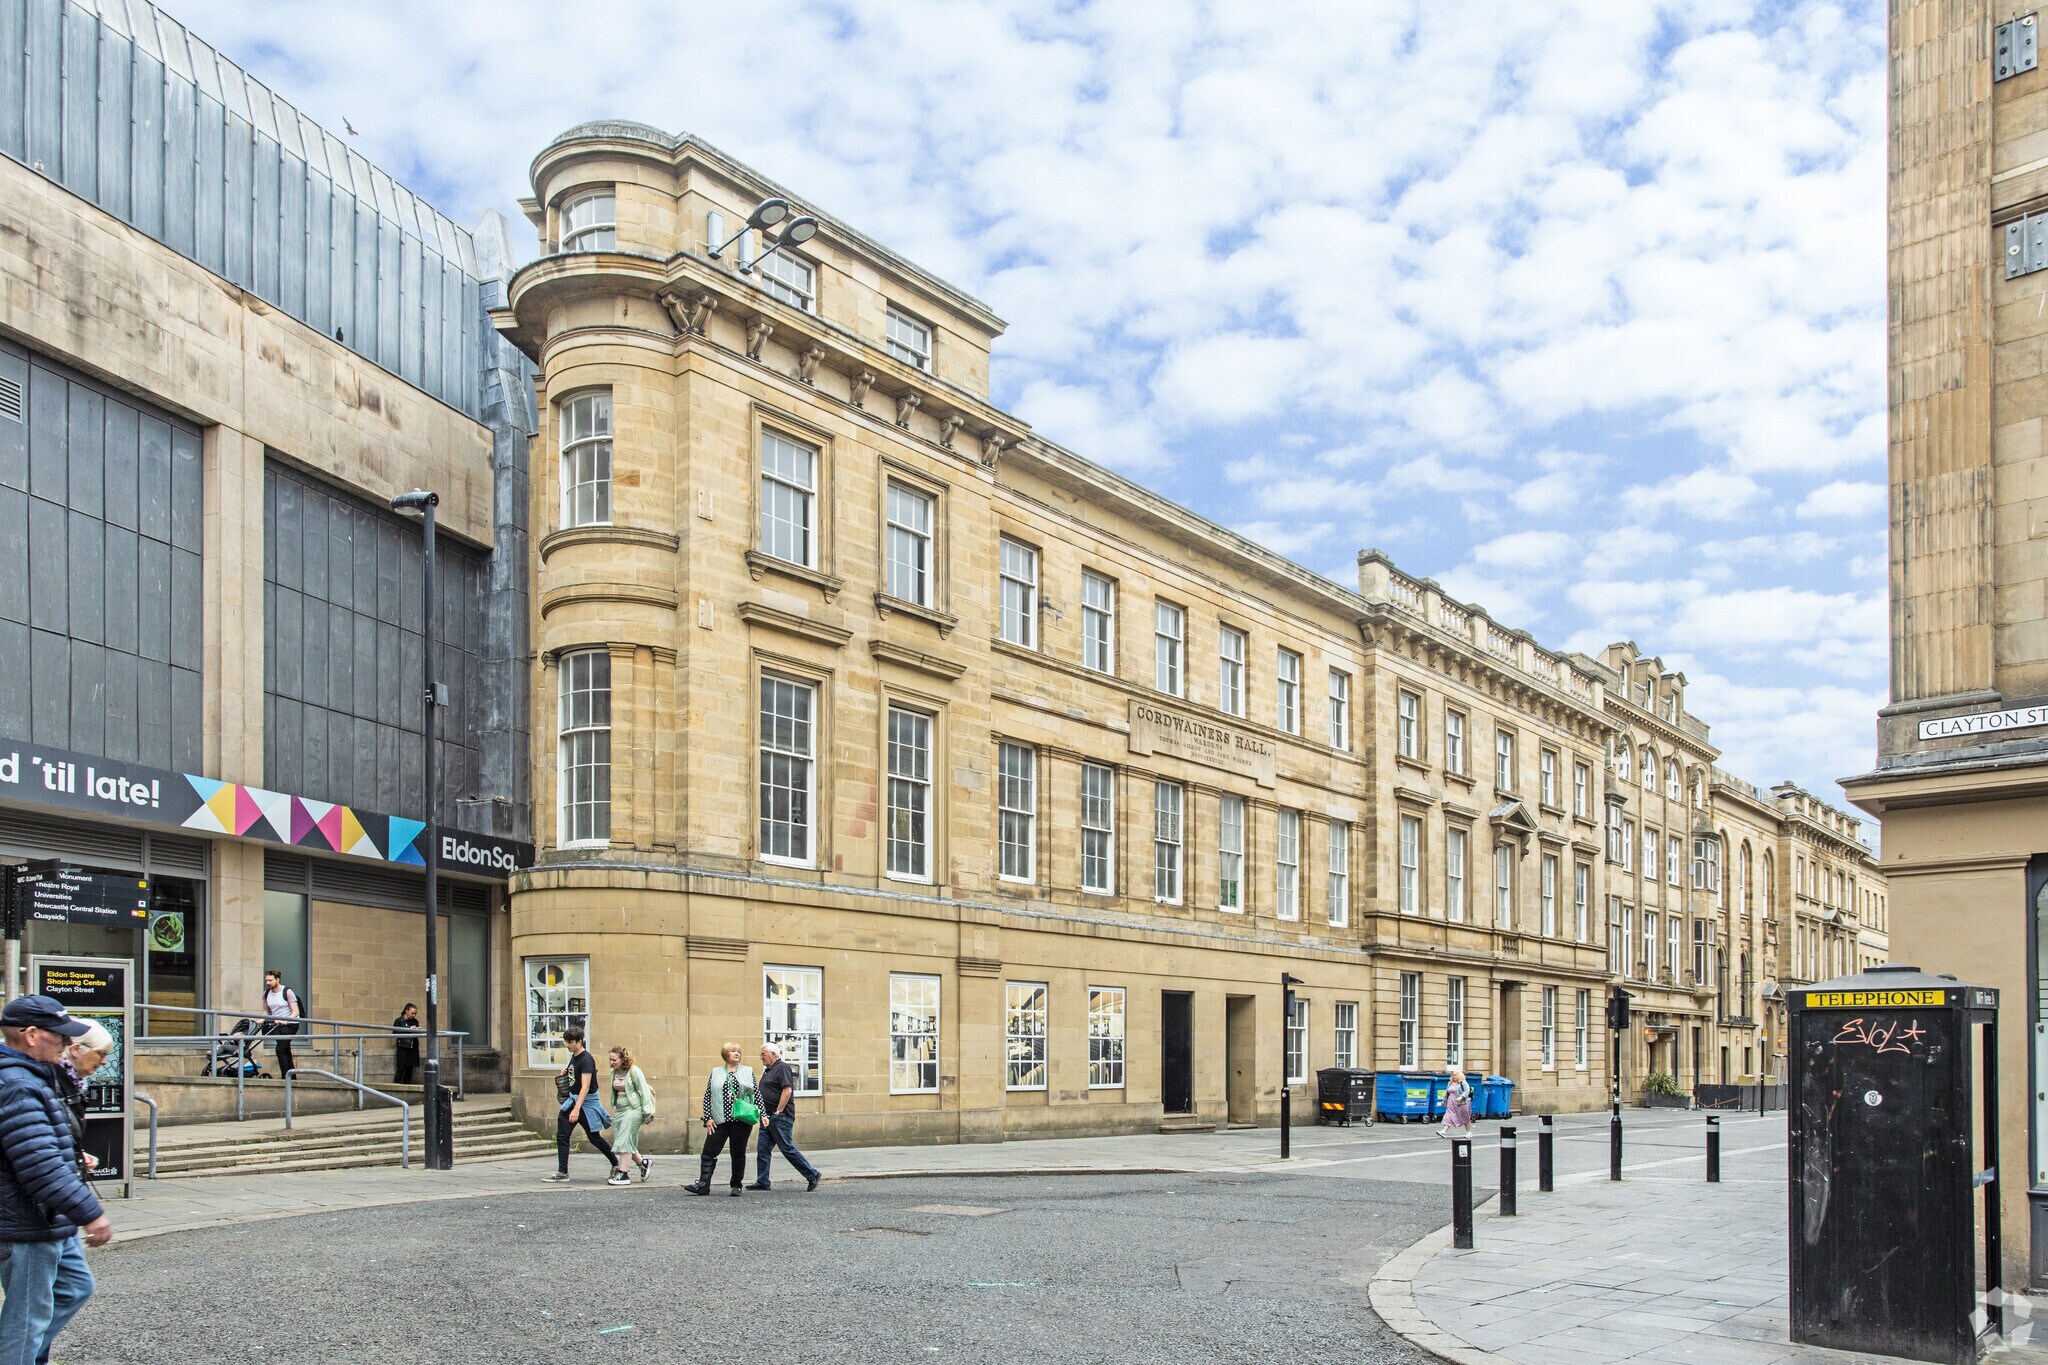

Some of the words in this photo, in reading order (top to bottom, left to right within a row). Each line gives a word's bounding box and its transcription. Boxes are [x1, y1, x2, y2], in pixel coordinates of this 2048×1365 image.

[1926, 711, 2018, 736] CLAYTON
[1137, 706, 1230, 745] CORDWAINERS
[1235, 735, 1271, 757] HALL.
[1194, 737, 1223, 750] WARDENS
[86, 767, 160, 808] late!
[59, 873, 92, 882] Monument
[61, 883, 80, 892] Royal
[34, 891, 72, 900] Universities
[34, 902, 69, 911] Newcastle
[70, 904, 94, 912] Central
[94, 906, 118, 915] Station
[34, 912, 66, 921] Quayside
[69, 971, 95, 979] Square
[47, 978, 82, 986] Shopping
[83, 979, 107, 987] Centre
[46, 985, 72, 994] Clayton
[1815, 991, 1934, 1006] TELEPHONE
